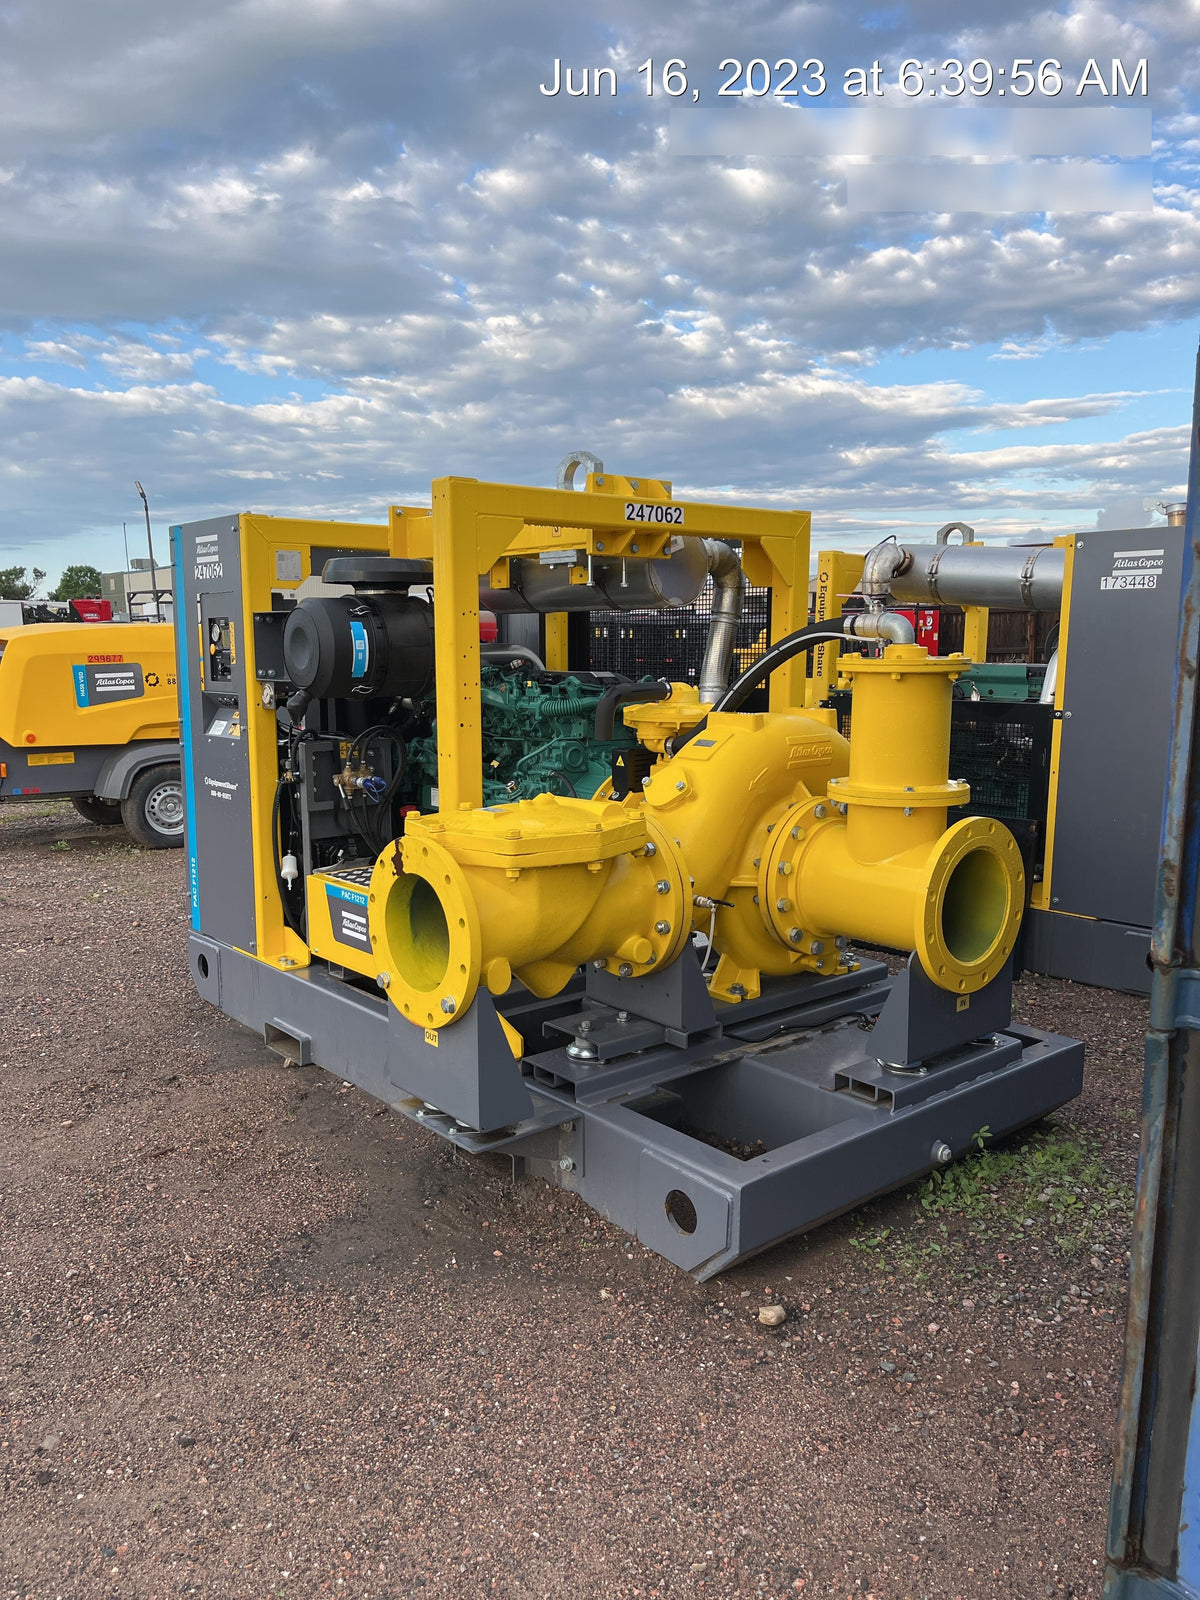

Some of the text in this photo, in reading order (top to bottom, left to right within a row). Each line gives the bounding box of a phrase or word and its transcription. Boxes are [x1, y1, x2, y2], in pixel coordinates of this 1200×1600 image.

[626, 503, 682, 524] 247062
[1113, 557, 1164, 568] Atlas Copco
[194, 563, 223, 579] 247062
[1102, 575, 1156, 589] 173448
[88, 655, 123, 663] 299677
[96, 677, 135, 686] Atlas Copco
[341, 890, 366, 905] PAC F1212
